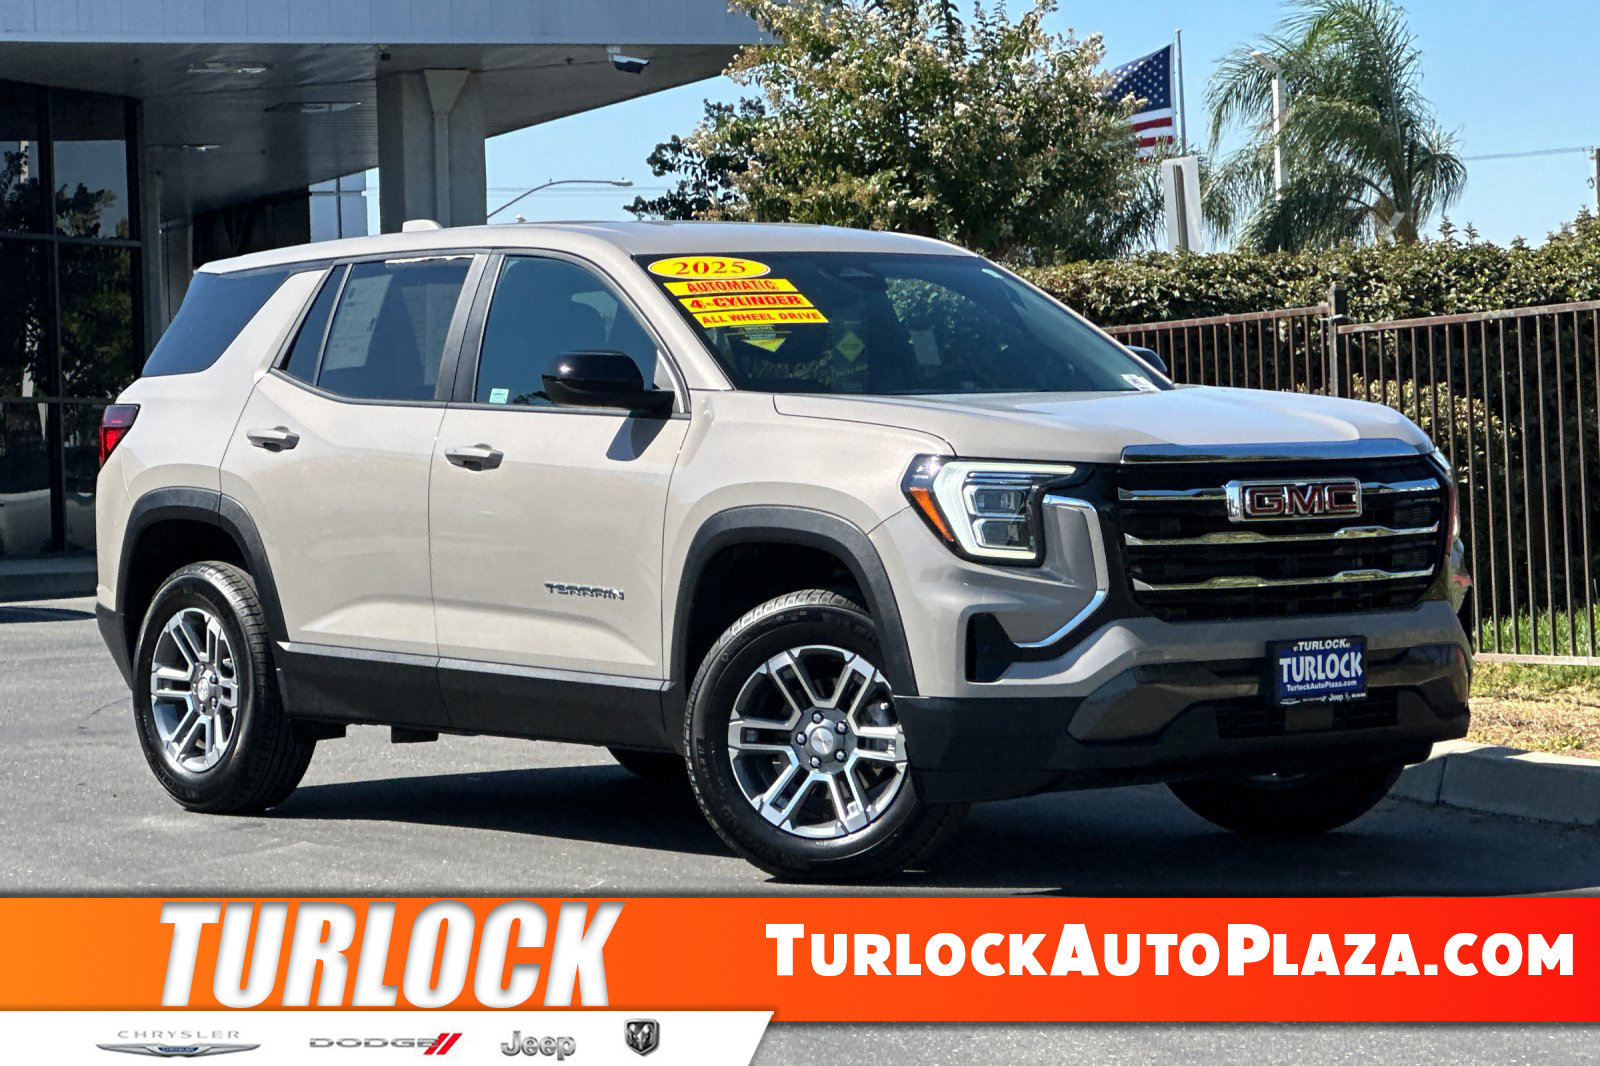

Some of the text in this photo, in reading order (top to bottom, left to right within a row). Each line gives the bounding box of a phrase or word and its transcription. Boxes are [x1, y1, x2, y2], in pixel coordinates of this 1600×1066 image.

[672, 260, 747, 275] 2025
[687, 279, 779, 293] AUTOMATIC
[690, 294, 803, 309] 4-CYLINDER
[702, 312, 821, 325] ALL WHEEL DRIVE
[1245, 484, 1359, 516] GMC
[543, 581, 625, 601] TERRAIN
[1297, 639, 1347, 652] TURLOCK
[1279, 651, 1363, 683] TURLOCK
[1286, 680, 1358, 692] TurlockAutoPlaza.com
